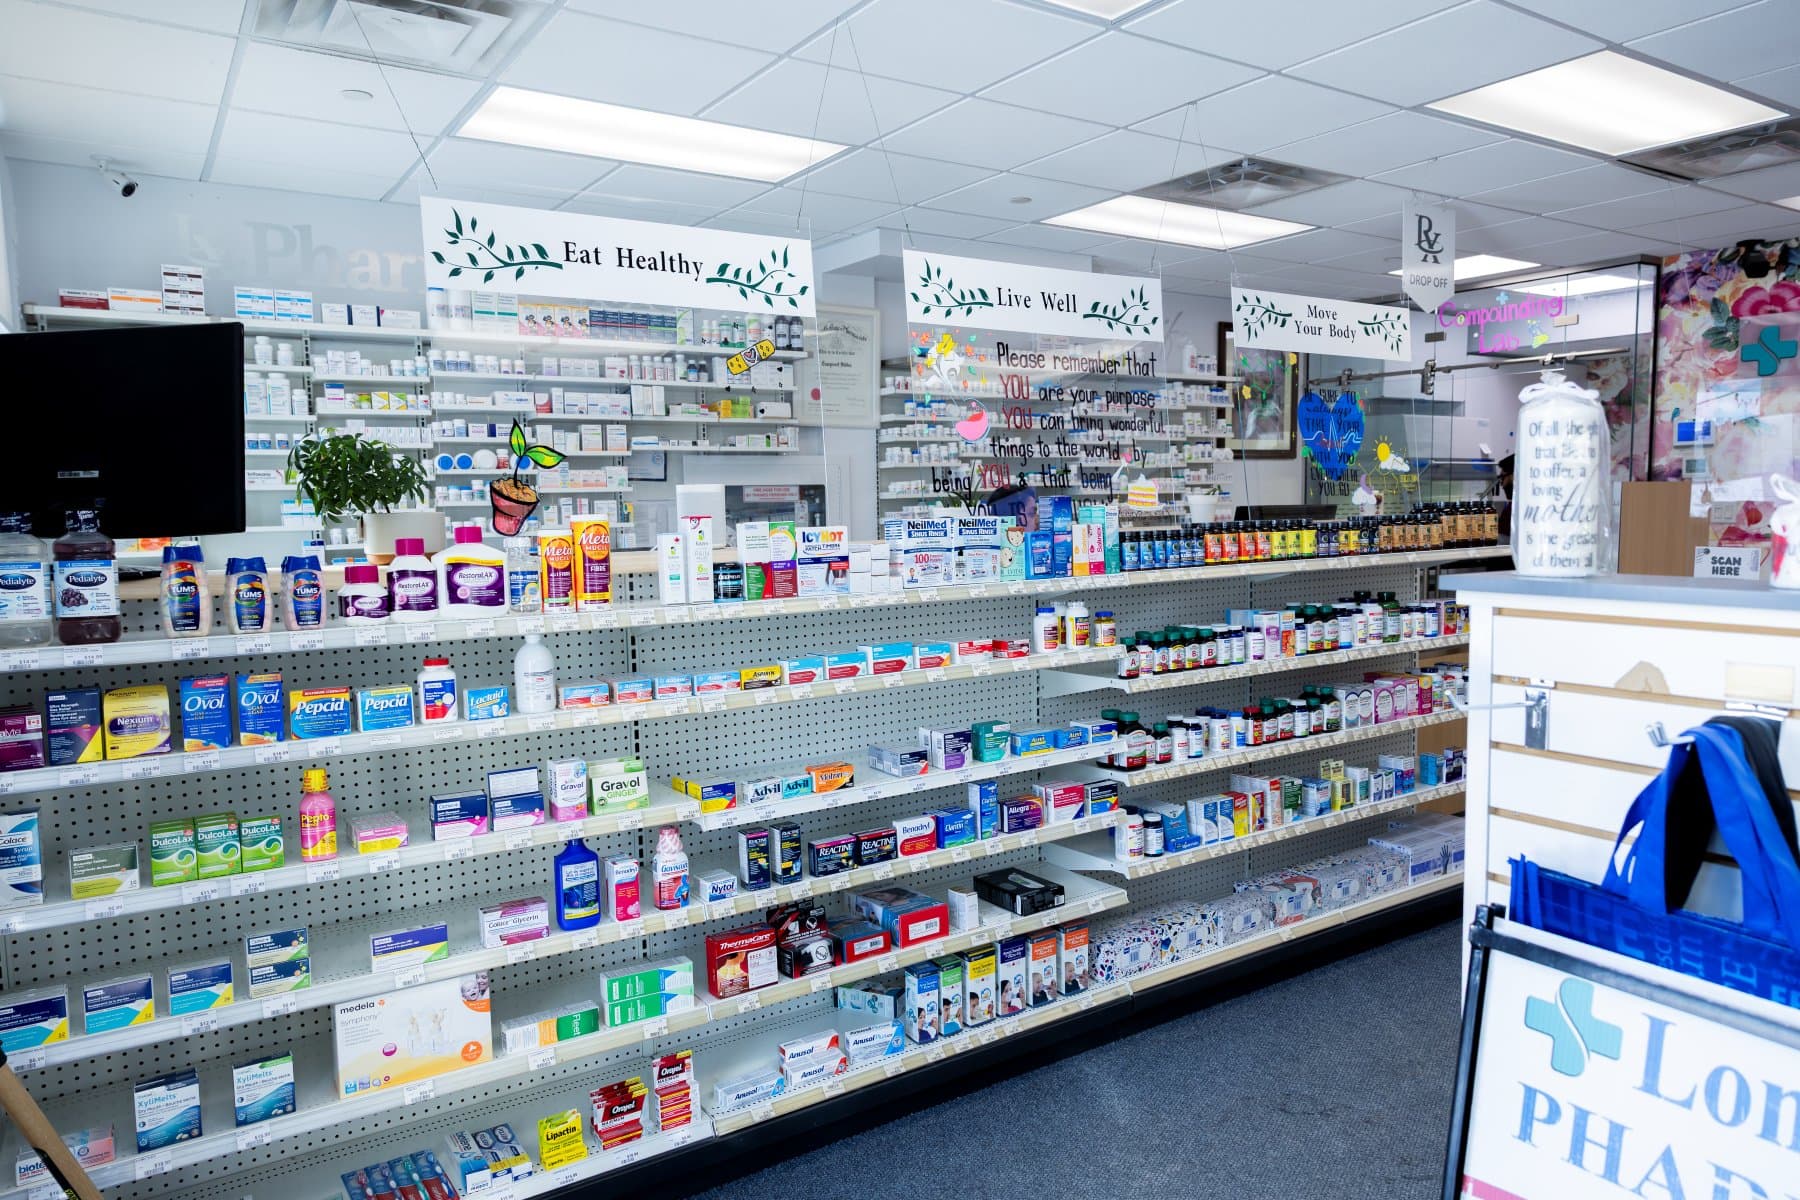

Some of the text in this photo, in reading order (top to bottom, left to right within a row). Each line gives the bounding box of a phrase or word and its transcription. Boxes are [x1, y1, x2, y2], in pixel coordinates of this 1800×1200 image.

[563, 240, 704, 282] Eat Healthy
[1410, 273, 1448, 288] DROP OFF
[997, 286, 1078, 313] Live Well
[1306, 303, 1338, 321] Move
[1438, 293, 1563, 329] Compounding
[1294, 319, 1357, 344] Your Body
[1478, 332, 1520, 354] Lab
[997, 341, 1157, 377] Please remember that
[999, 374, 1156, 413] YOU are your purpose
[1002, 406, 1166, 441] YOU can bring wonderful
[990, 434, 1147, 468] things to the world by
[1530, 466, 1540, 479] to
[1580, 467, 1586, 477] a
[932, 463, 1113, 503] being YOU & that being
[1319, 481, 1336, 496] YOU
[907, 520, 947, 530] NeilMed
[959, 518, 997, 527] NeilMed
[915, 553, 930, 564] 100
[1711, 555, 1742, 567] SCAN
[1711, 566, 1740, 577] HERE
[69, 574, 106, 584] Pedialyte
[171, 585, 196, 594] TUMS
[238, 590, 263, 599] TUMS
[295, 587, 318, 595] TUMS
[1130, 657, 1136, 666] A
[184, 694, 225, 712] Ovol
[241, 689, 279, 706] Ovol
[365, 694, 408, 711] Pepcid
[470, 688, 504, 707] Lactaid
[295, 697, 345, 715] Pepcid
[117, 716, 153, 726] Nexium
[560, 781, 584, 791] Gravol
[600, 776, 641, 792] Gravol
[752, 783, 781, 798] Advil
[785, 779, 809, 792] Advil
[606, 789, 637, 799] GINGER
[1008, 804, 1029, 815] Allegra
[301, 812, 334, 823] Pepto-
[198, 828, 238, 842] DulcoLax
[241, 823, 281, 836] DulcoLax
[902, 822, 931, 834] Benadryl
[152, 834, 194, 848] DulcoLax
[861, 836, 896, 850] REACTINE
[819, 843, 852, 857] REACTINE
[711, 881, 735, 894] Nytol
[512, 913, 539, 926] Glycerin
[719, 932, 772, 950] ThermaCare
[340, 1000, 375, 1015] medela
[572, 1013, 582, 1035] Fleet
[852, 1035, 876, 1047] Anusol
[788, 1046, 814, 1060] Anusol
[236, 1070, 273, 1083] XyliMelts
[800, 1065, 825, 1080] Anusol
[137, 1093, 177, 1108] XyliMelts
[734, 1086, 758, 1101] Anusol
[546, 1124, 577, 1141] Lipactin
[1511, 1080, 1800, 1200] PHAR
